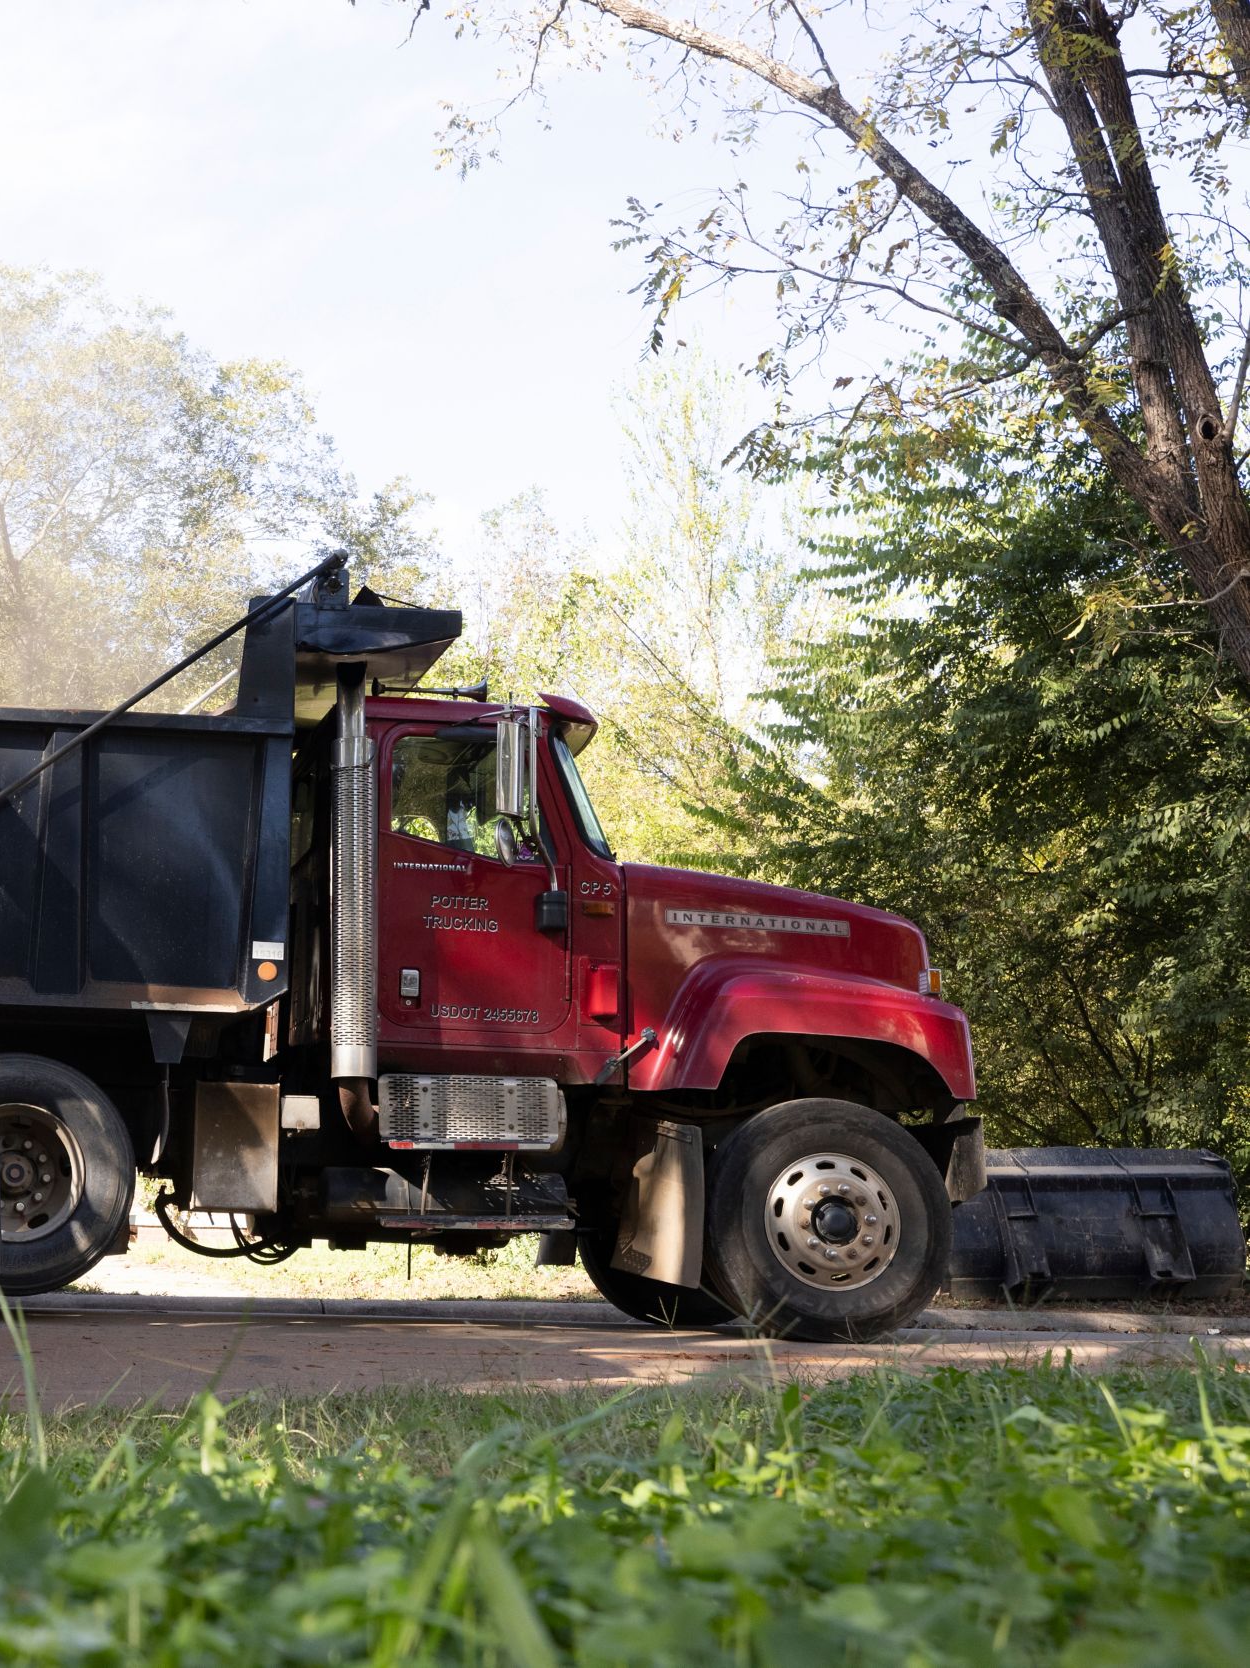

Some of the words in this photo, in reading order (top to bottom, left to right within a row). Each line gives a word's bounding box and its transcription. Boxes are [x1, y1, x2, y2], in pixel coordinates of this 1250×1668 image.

[393, 862, 468, 872] INTERNATIONAL
[580, 881, 600, 895] CP
[603, 882, 612, 896] 5
[430, 895, 489, 911] POTTER
[422, 915, 499, 933] TRUCKING
[672, 912, 844, 934] INTERNATIONAL
[430, 1003, 480, 1020] USDOT
[483, 1007, 539, 1024] 2455678
